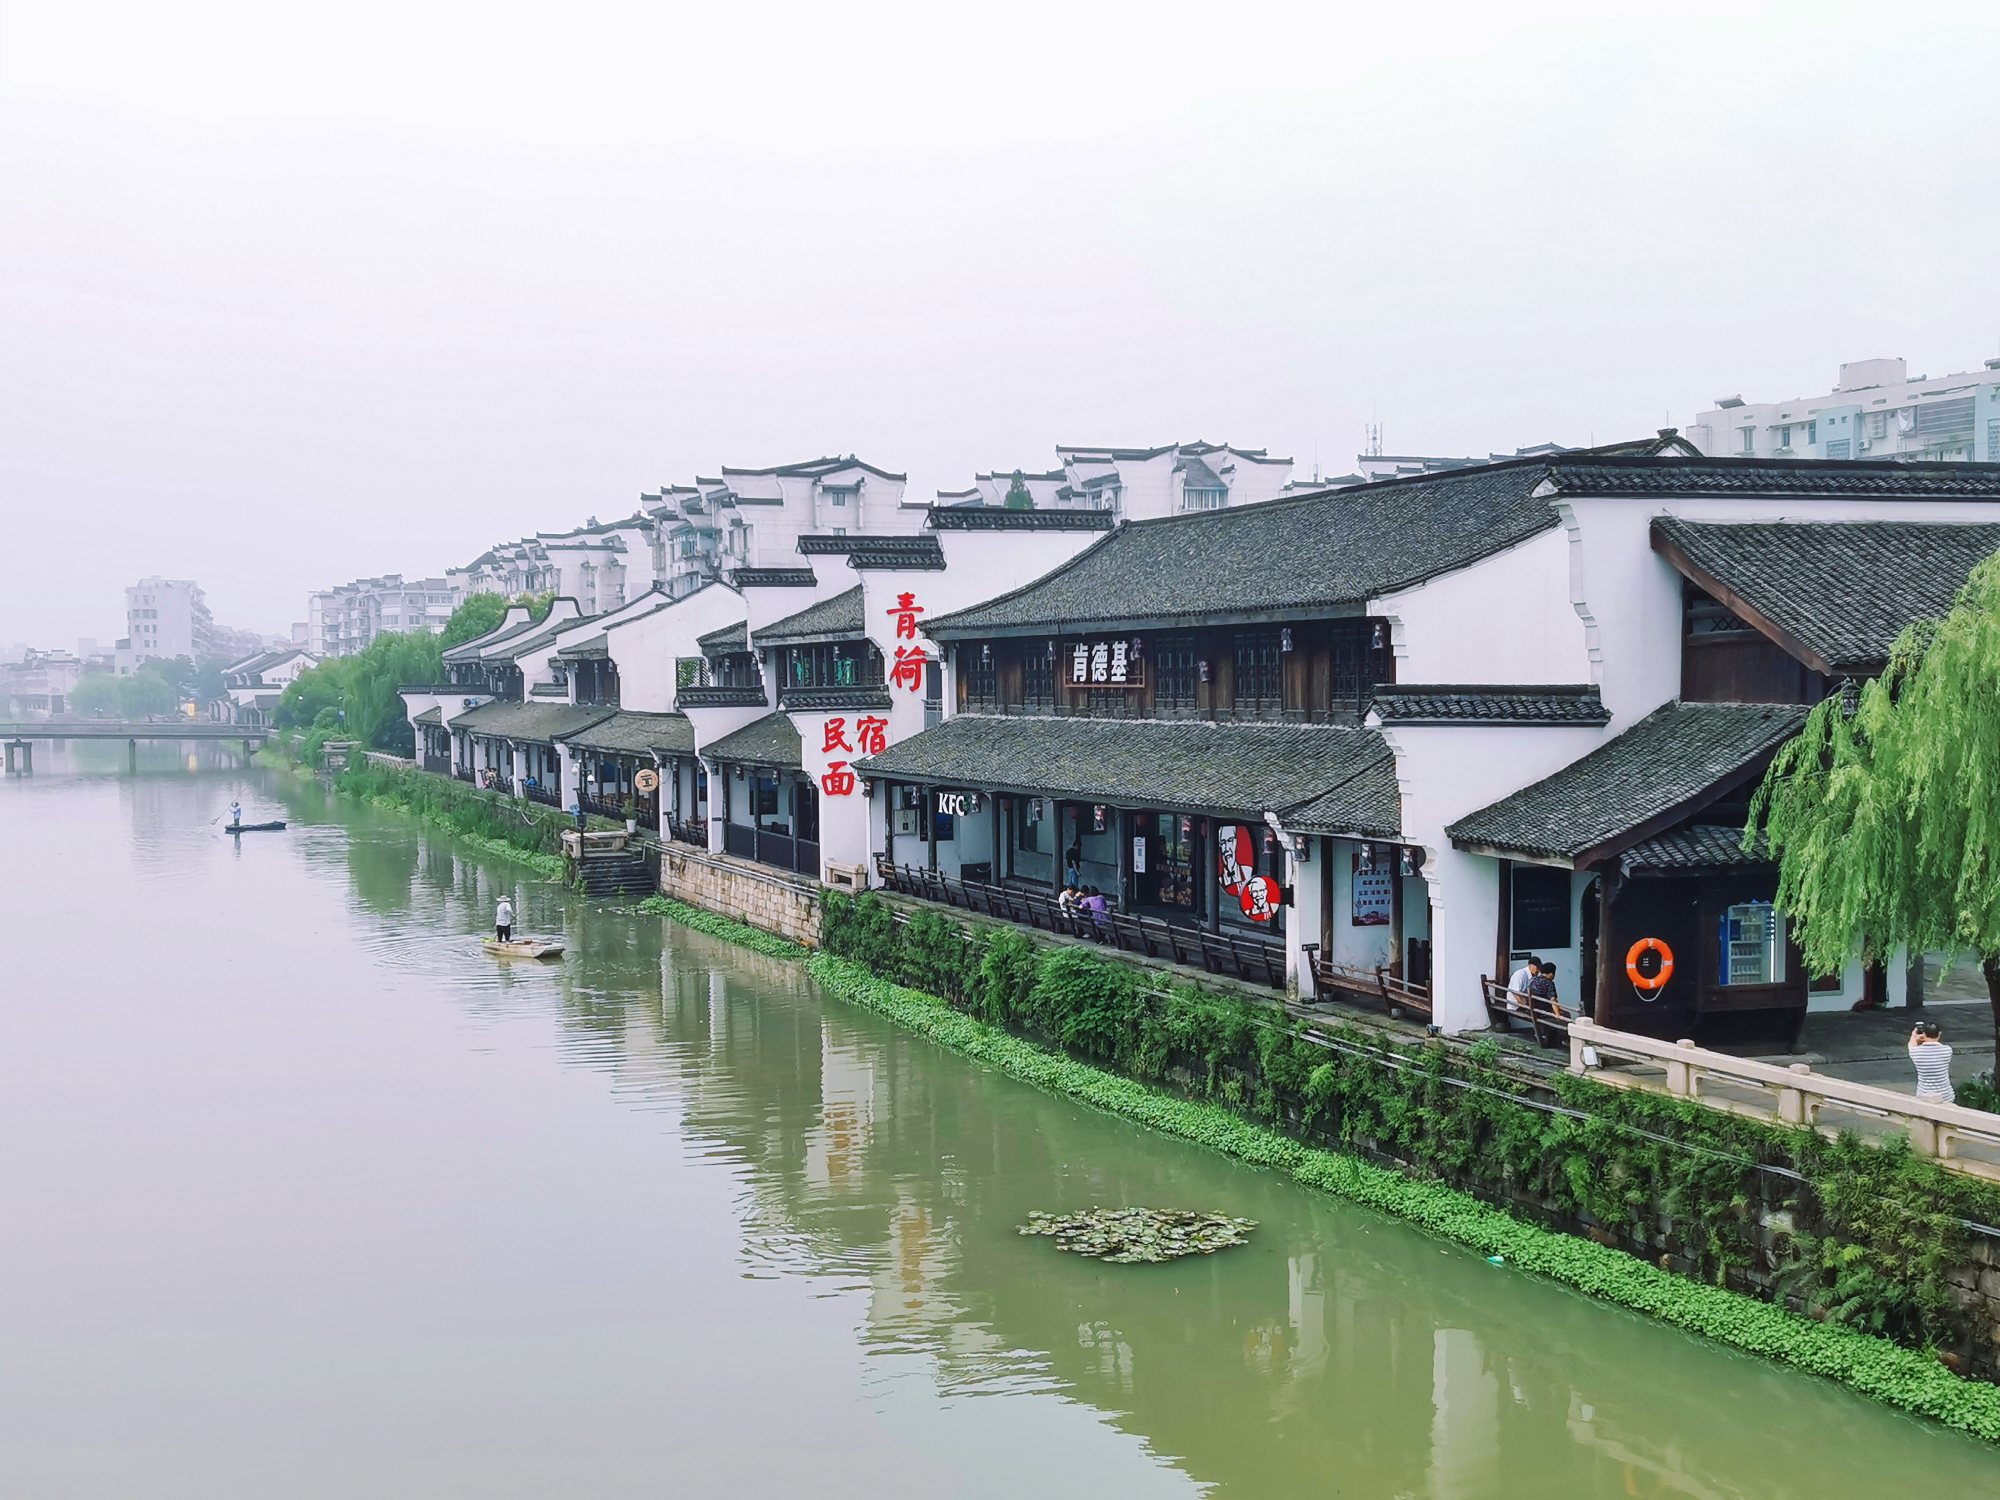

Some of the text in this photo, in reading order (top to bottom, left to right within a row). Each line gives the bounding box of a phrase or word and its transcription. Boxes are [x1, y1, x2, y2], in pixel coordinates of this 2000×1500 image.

[887, 592, 928, 693] 青荷
[1072, 640, 1128, 683] 肯德基
[822, 715, 889, 755] 民宿
[821, 761, 856, 797] 面
[938, 792, 965, 817] KFC
